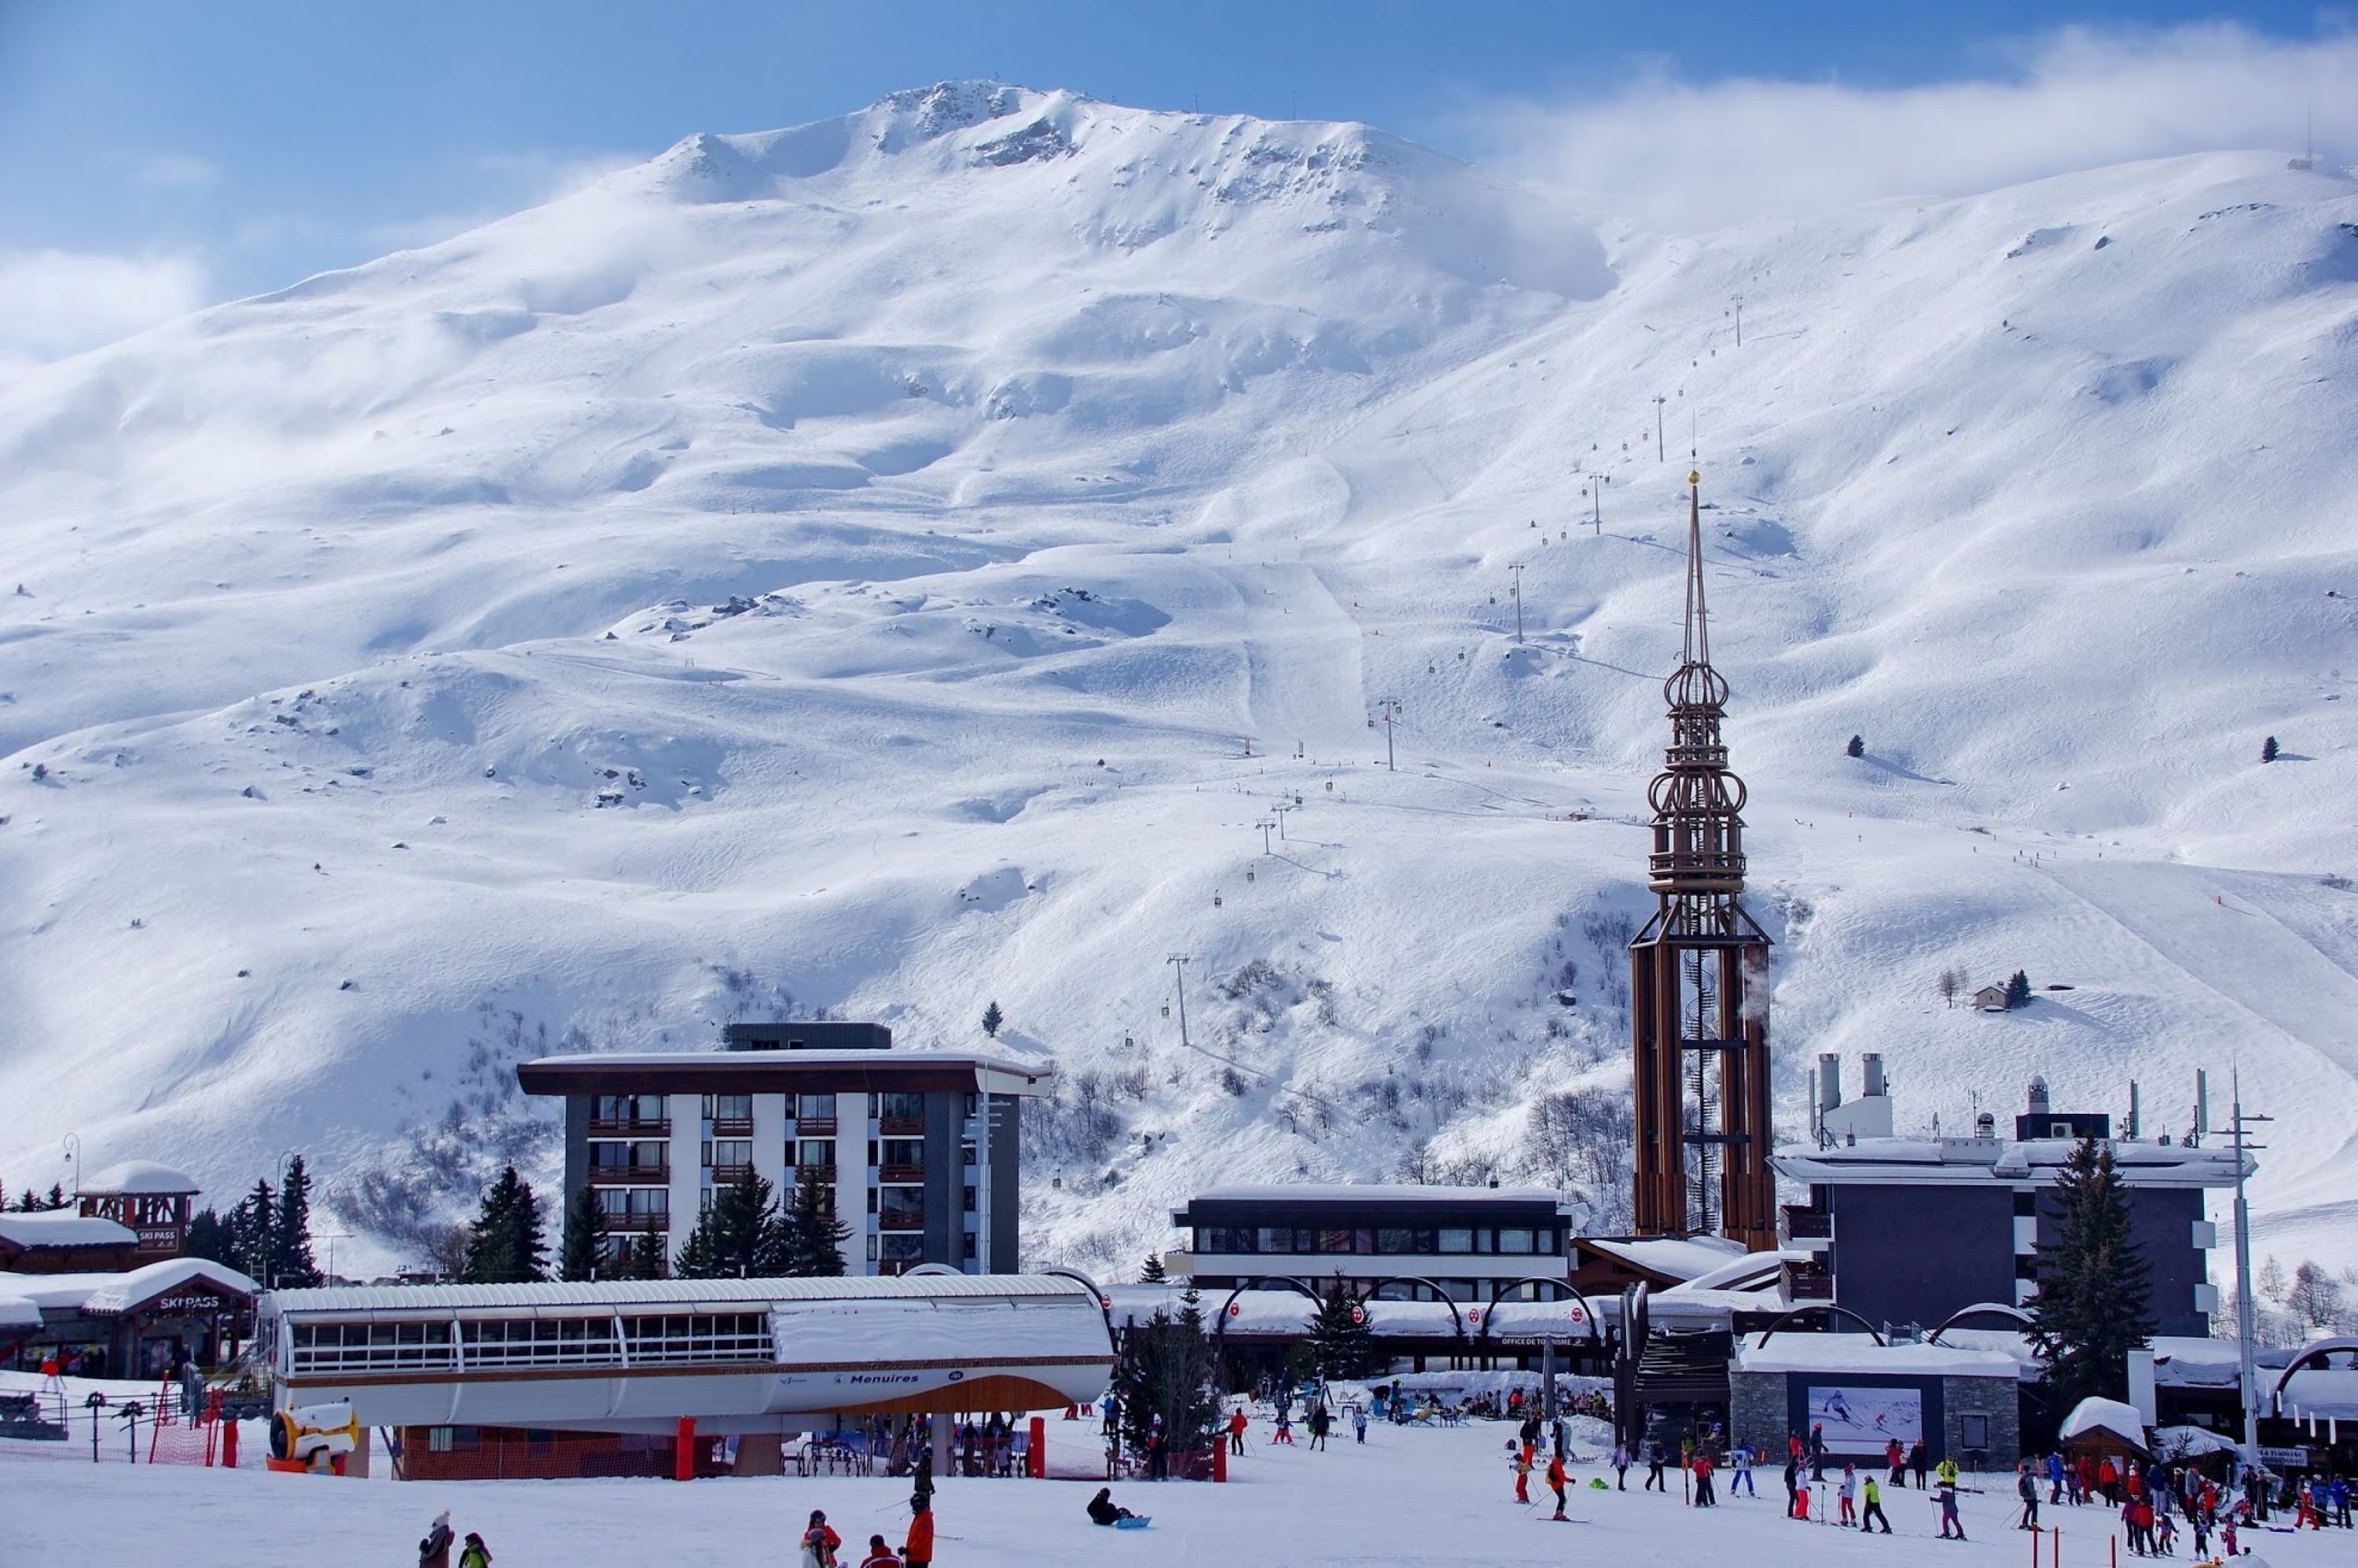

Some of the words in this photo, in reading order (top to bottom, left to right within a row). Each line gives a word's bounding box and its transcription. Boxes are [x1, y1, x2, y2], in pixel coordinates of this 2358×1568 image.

[140, 1232, 153, 1240] SKI
[154, 1231, 174, 1239] PASS
[160, 1298, 182, 1309] SKI
[185, 1296, 219, 1308] PASS
[850, 1374, 919, 1383] Menuires
